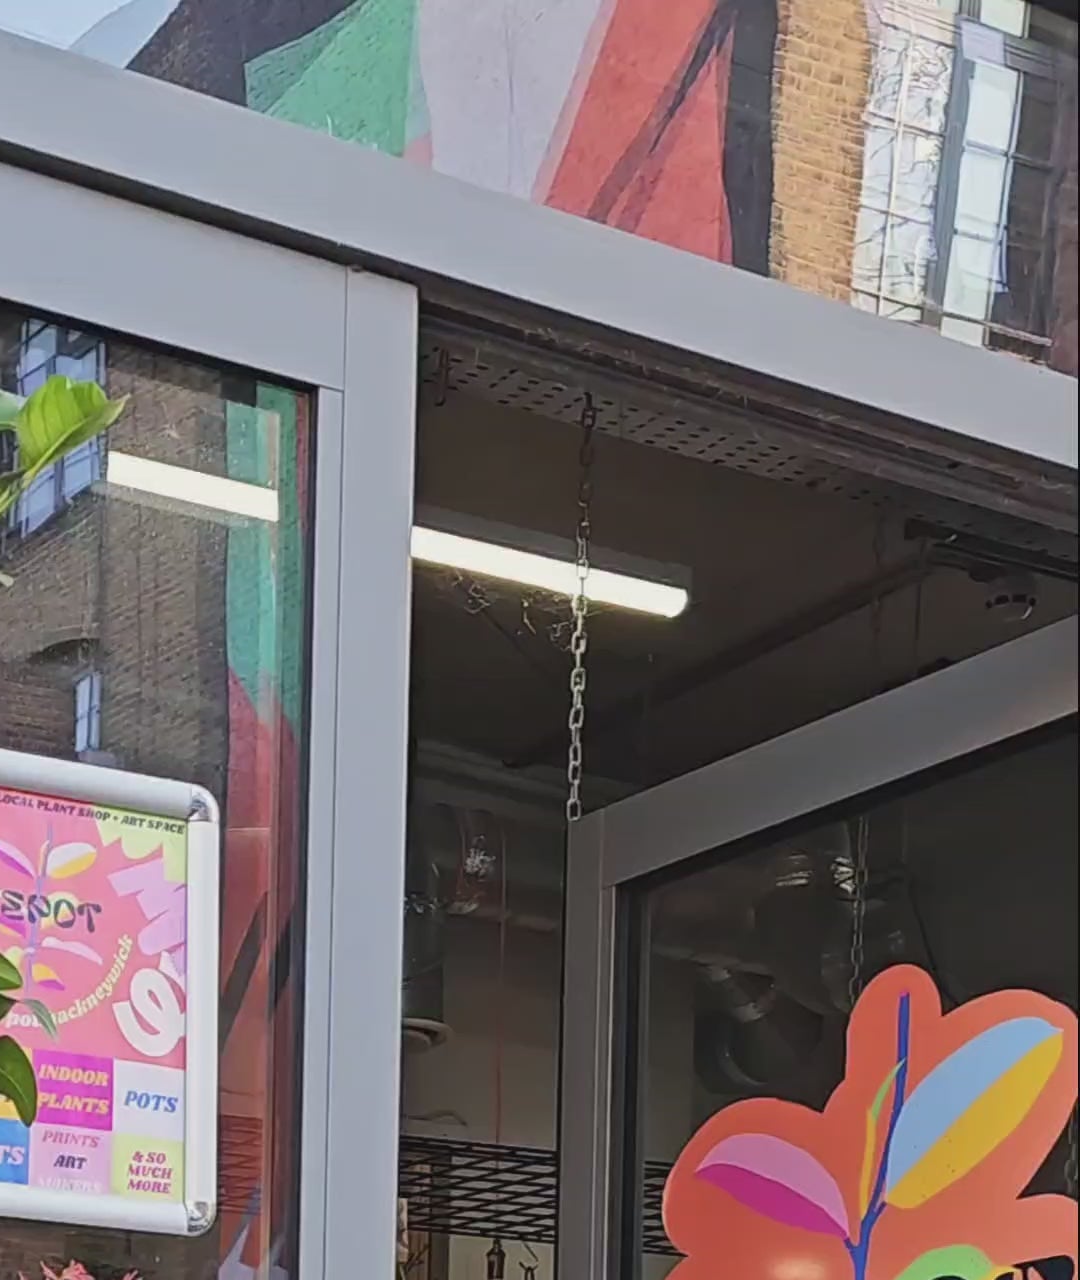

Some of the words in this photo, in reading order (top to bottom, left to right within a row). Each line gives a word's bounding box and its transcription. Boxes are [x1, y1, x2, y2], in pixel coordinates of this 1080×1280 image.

[37, 800, 75, 815] PLANT
[78, 807, 111, 821] SHOP
[121, 815, 146, 828] ART
[147, 821, 185, 835] SPACE
[38, 1064, 109, 1087] INDOOR
[36, 1091, 109, 1115] PLANTS
[124, 1090, 178, 1113] POTS
[42, 1129, 101, 1148] PRINTS
[53, 1155, 87, 1170] ART
[146, 1152, 166, 1164] SO
[127, 1164, 174, 1180] MUCH
[127, 1178, 172, 1194] MORE
